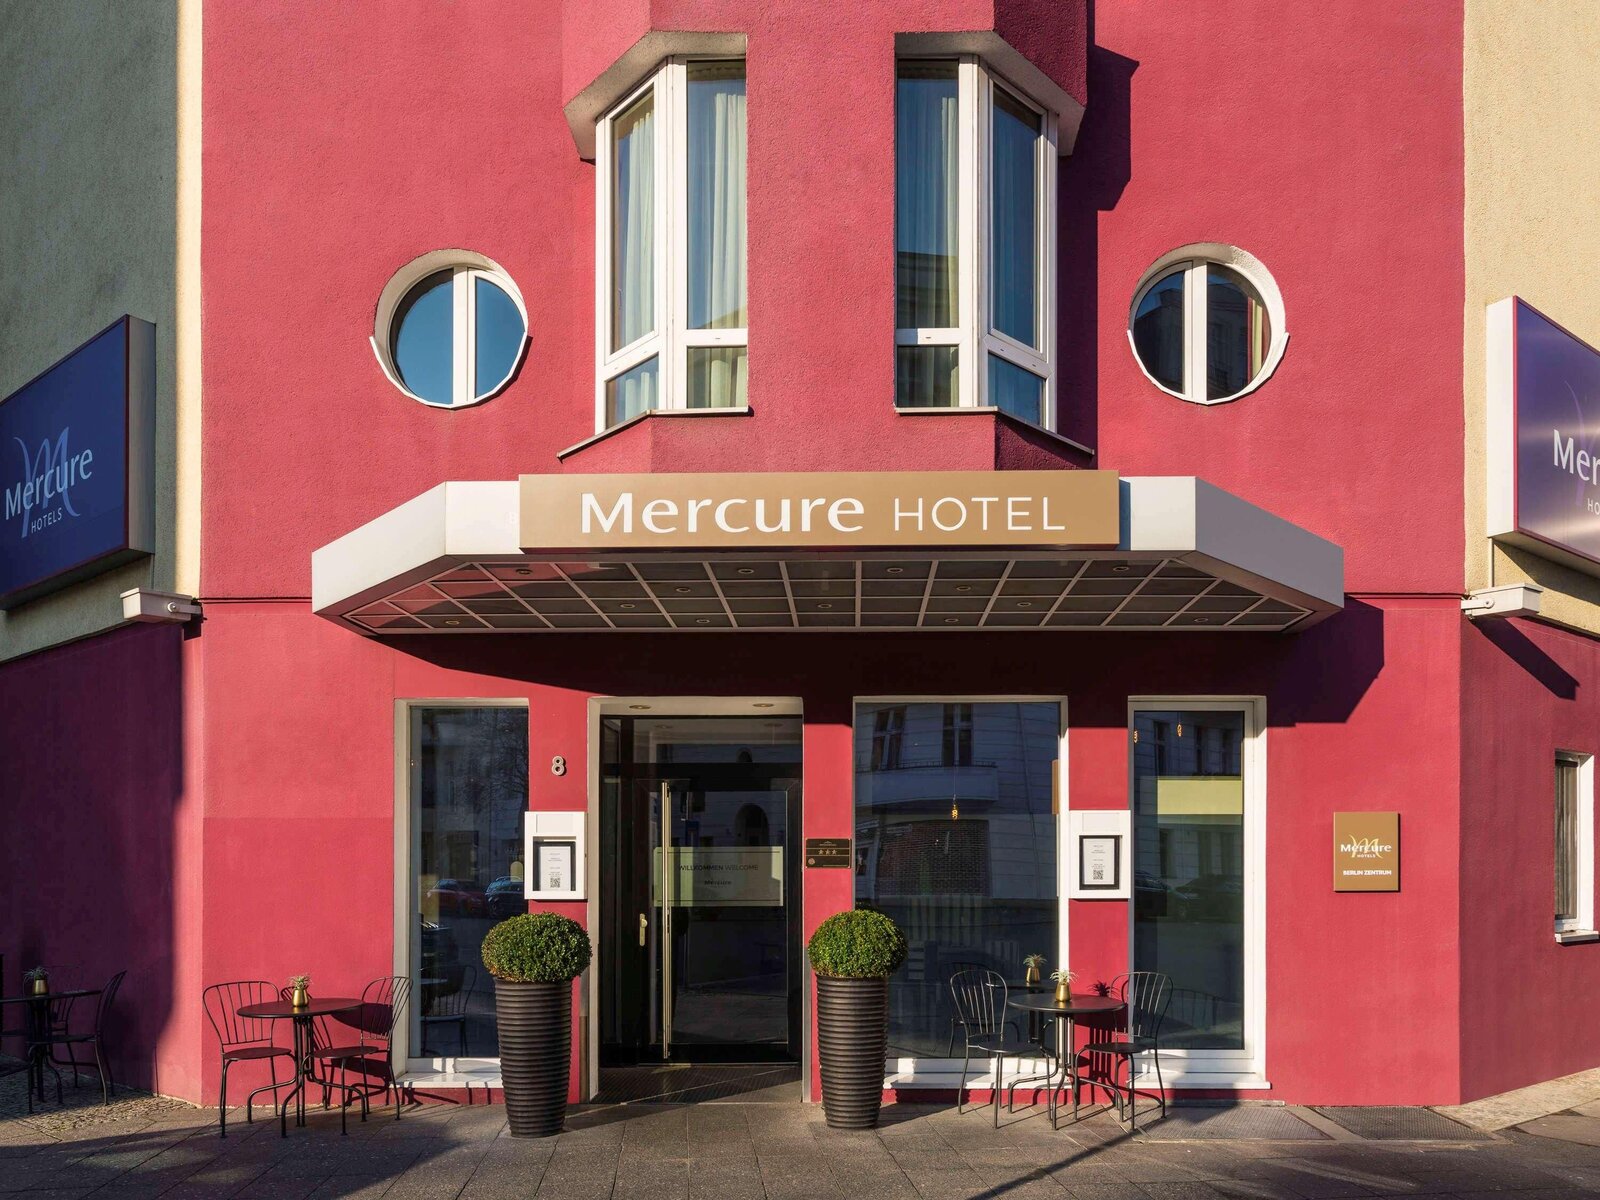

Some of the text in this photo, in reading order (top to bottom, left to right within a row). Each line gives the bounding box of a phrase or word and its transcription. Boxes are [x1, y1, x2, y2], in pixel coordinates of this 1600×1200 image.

[5, 449, 93, 520] Mercure
[31, 507, 62, 533] HOTELS
[580, 492, 1066, 534] Mercure HOTEL
[551, 755, 566, 776] 8
[1340, 844, 1392, 852] Mercure
